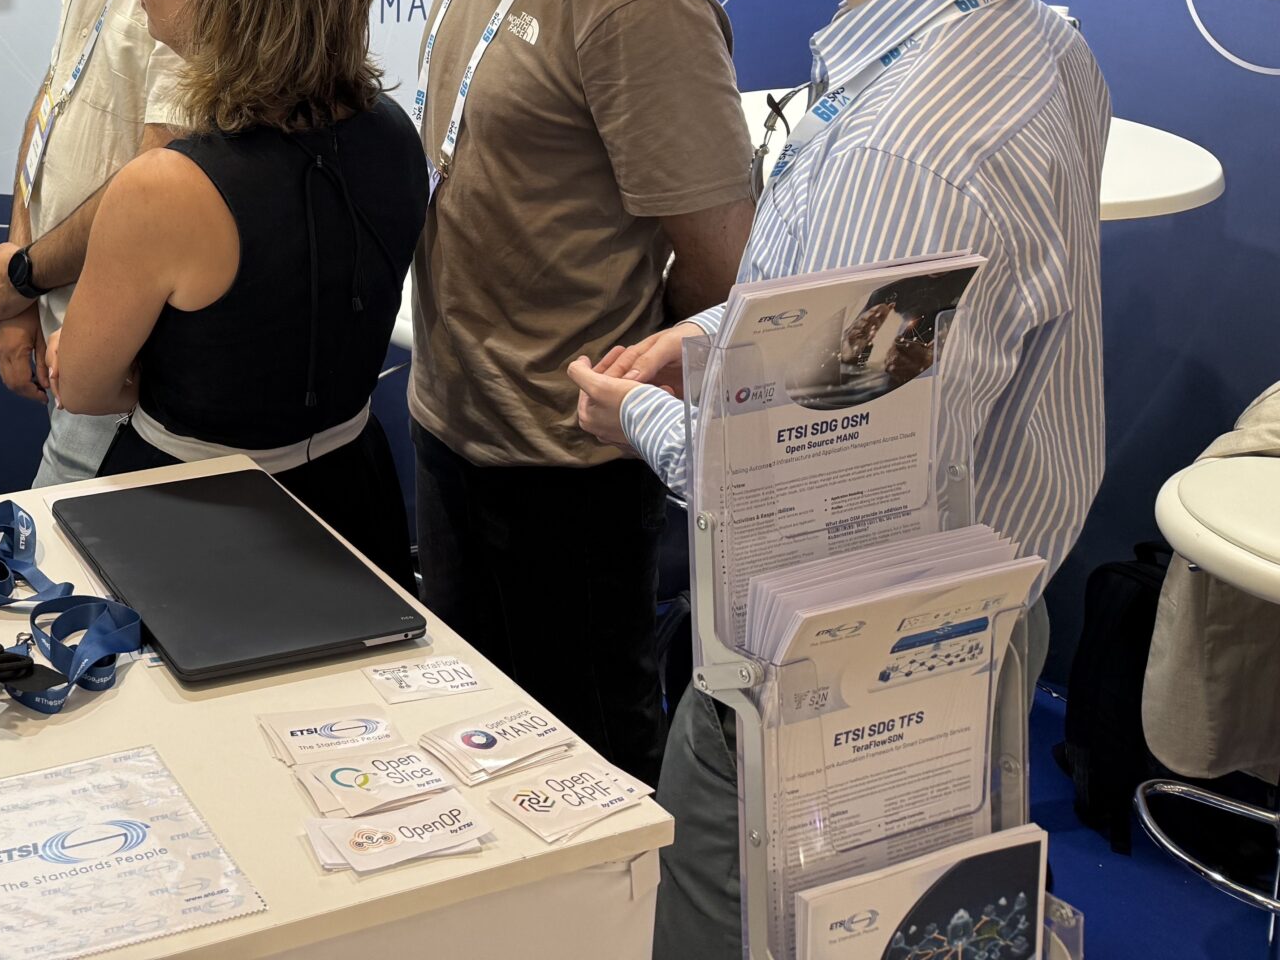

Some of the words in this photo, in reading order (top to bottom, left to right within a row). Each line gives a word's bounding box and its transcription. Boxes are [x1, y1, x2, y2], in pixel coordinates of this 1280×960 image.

[507, 13, 529, 31] NORTH
[520, 11, 533, 24] THE
[483, 27, 495, 43] 6G
[507, 25, 526, 38] FACE
[811, 98, 839, 123] 6G
[827, 86, 845, 103] SNS
[777, 424, 808, 443] ETSI
[811, 418, 838, 436] SDG
[841, 411, 870, 429] OSM
[776, 453, 811, 465] Infrastructure
[821, 445, 850, 456] Application
[850, 438, 882, 450] Management
[785, 443, 806, 455] Open
[807, 438, 835, 450] Source
[835, 431, 860, 444] MANO
[414, 658, 460, 671] TeraFlow
[422, 666, 473, 685] SDN
[485, 718, 505, 731] Open
[504, 708, 532, 722] Source
[495, 715, 549, 741] MANO
[834, 726, 865, 747] ETSI
[868, 719, 895, 737] SDG
[899, 711, 925, 729] TFS
[290, 727, 318, 737] ETSI
[316, 738, 360, 749] Standards
[361, 733, 391, 743] People
[852, 732, 904, 754] TeraFlowSDN
[371, 753, 422, 777] Open
[386, 766, 434, 785] Slice
[545, 770, 595, 795] Open
[562, 780, 612, 807] CAPIF
[609, 796, 625, 807] ETSI
[398, 808, 462, 840] OpenOP
[458, 821, 473, 831] ETSI
[0, 880, 29, 893] The
[33, 859, 112, 885] Standards
[116, 845, 168, 867] People
